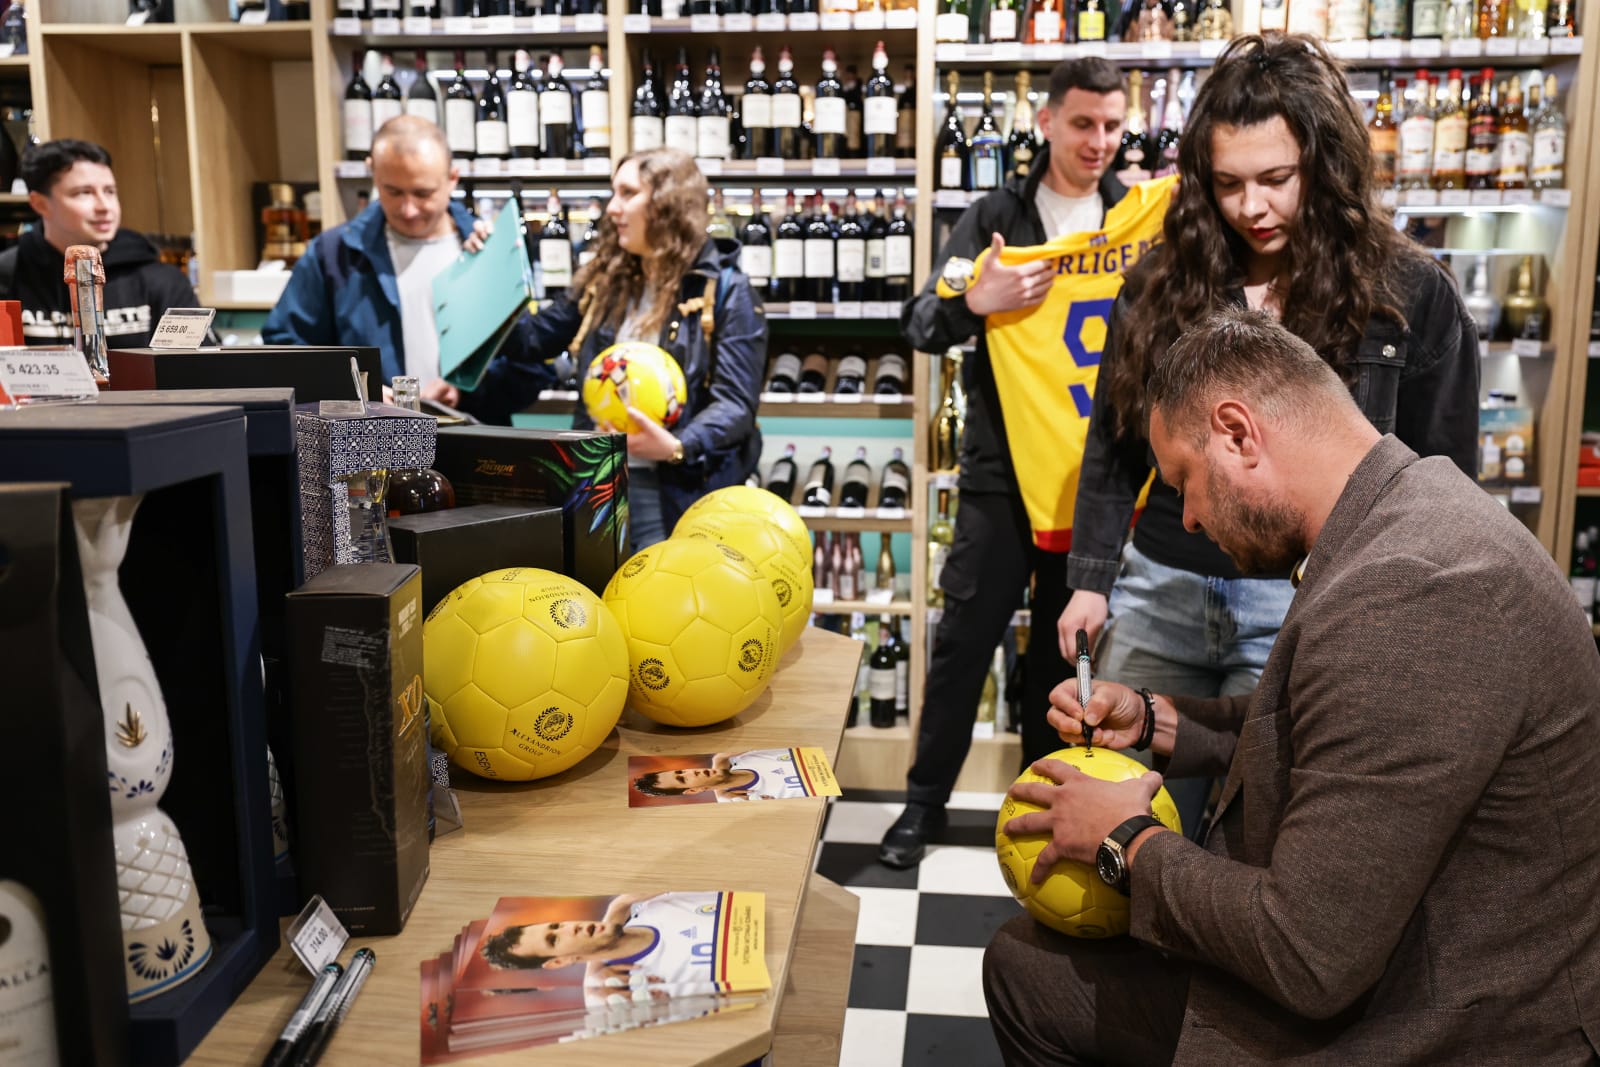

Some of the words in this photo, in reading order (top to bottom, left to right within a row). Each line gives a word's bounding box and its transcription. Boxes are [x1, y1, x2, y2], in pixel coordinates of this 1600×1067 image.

[18, 363, 60, 376] 423.35
[509, 728, 562, 756] ALEXANDRION
[518, 743, 544, 757] GROUP
[309, 927, 329, 954] 314.00
